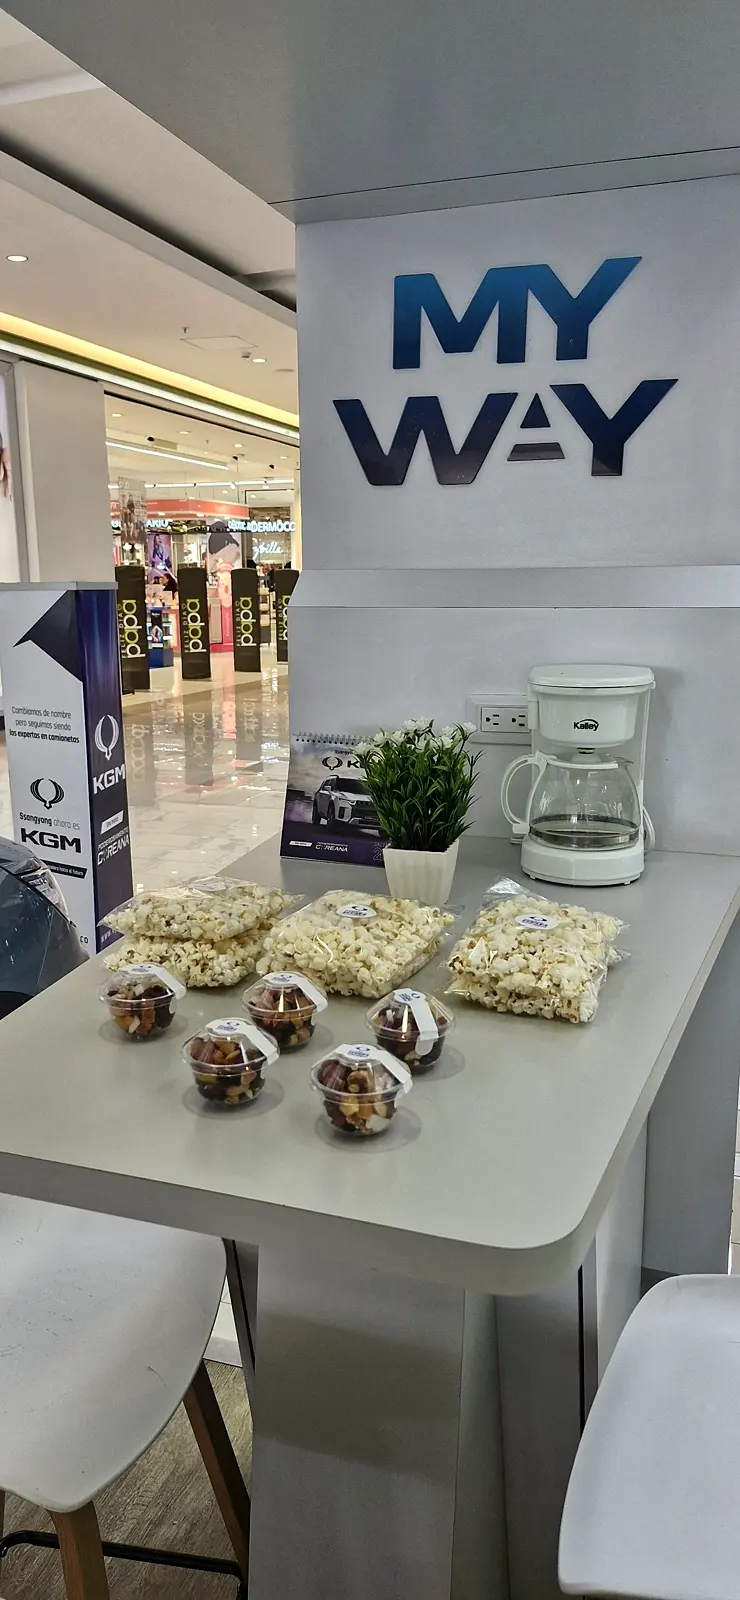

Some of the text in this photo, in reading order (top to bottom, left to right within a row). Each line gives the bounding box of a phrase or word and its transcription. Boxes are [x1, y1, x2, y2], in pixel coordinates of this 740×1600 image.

[393, 256, 642, 369] MY
[332, 378, 678, 486] WAY
[12, 706, 72, 719] Cambiamos de nombre
[15, 719, 71, 731] pero seguimos siendo
[573, 720, 599, 731] Kalley
[9, 728, 17, 736] los
[18, 731, 40, 739] expertos
[48, 734, 80, 744] camionetas
[93, 763, 126, 795] KGM
[19, 811, 80, 831] Ssangyong ahora es
[20, 827, 82, 854] KGM
